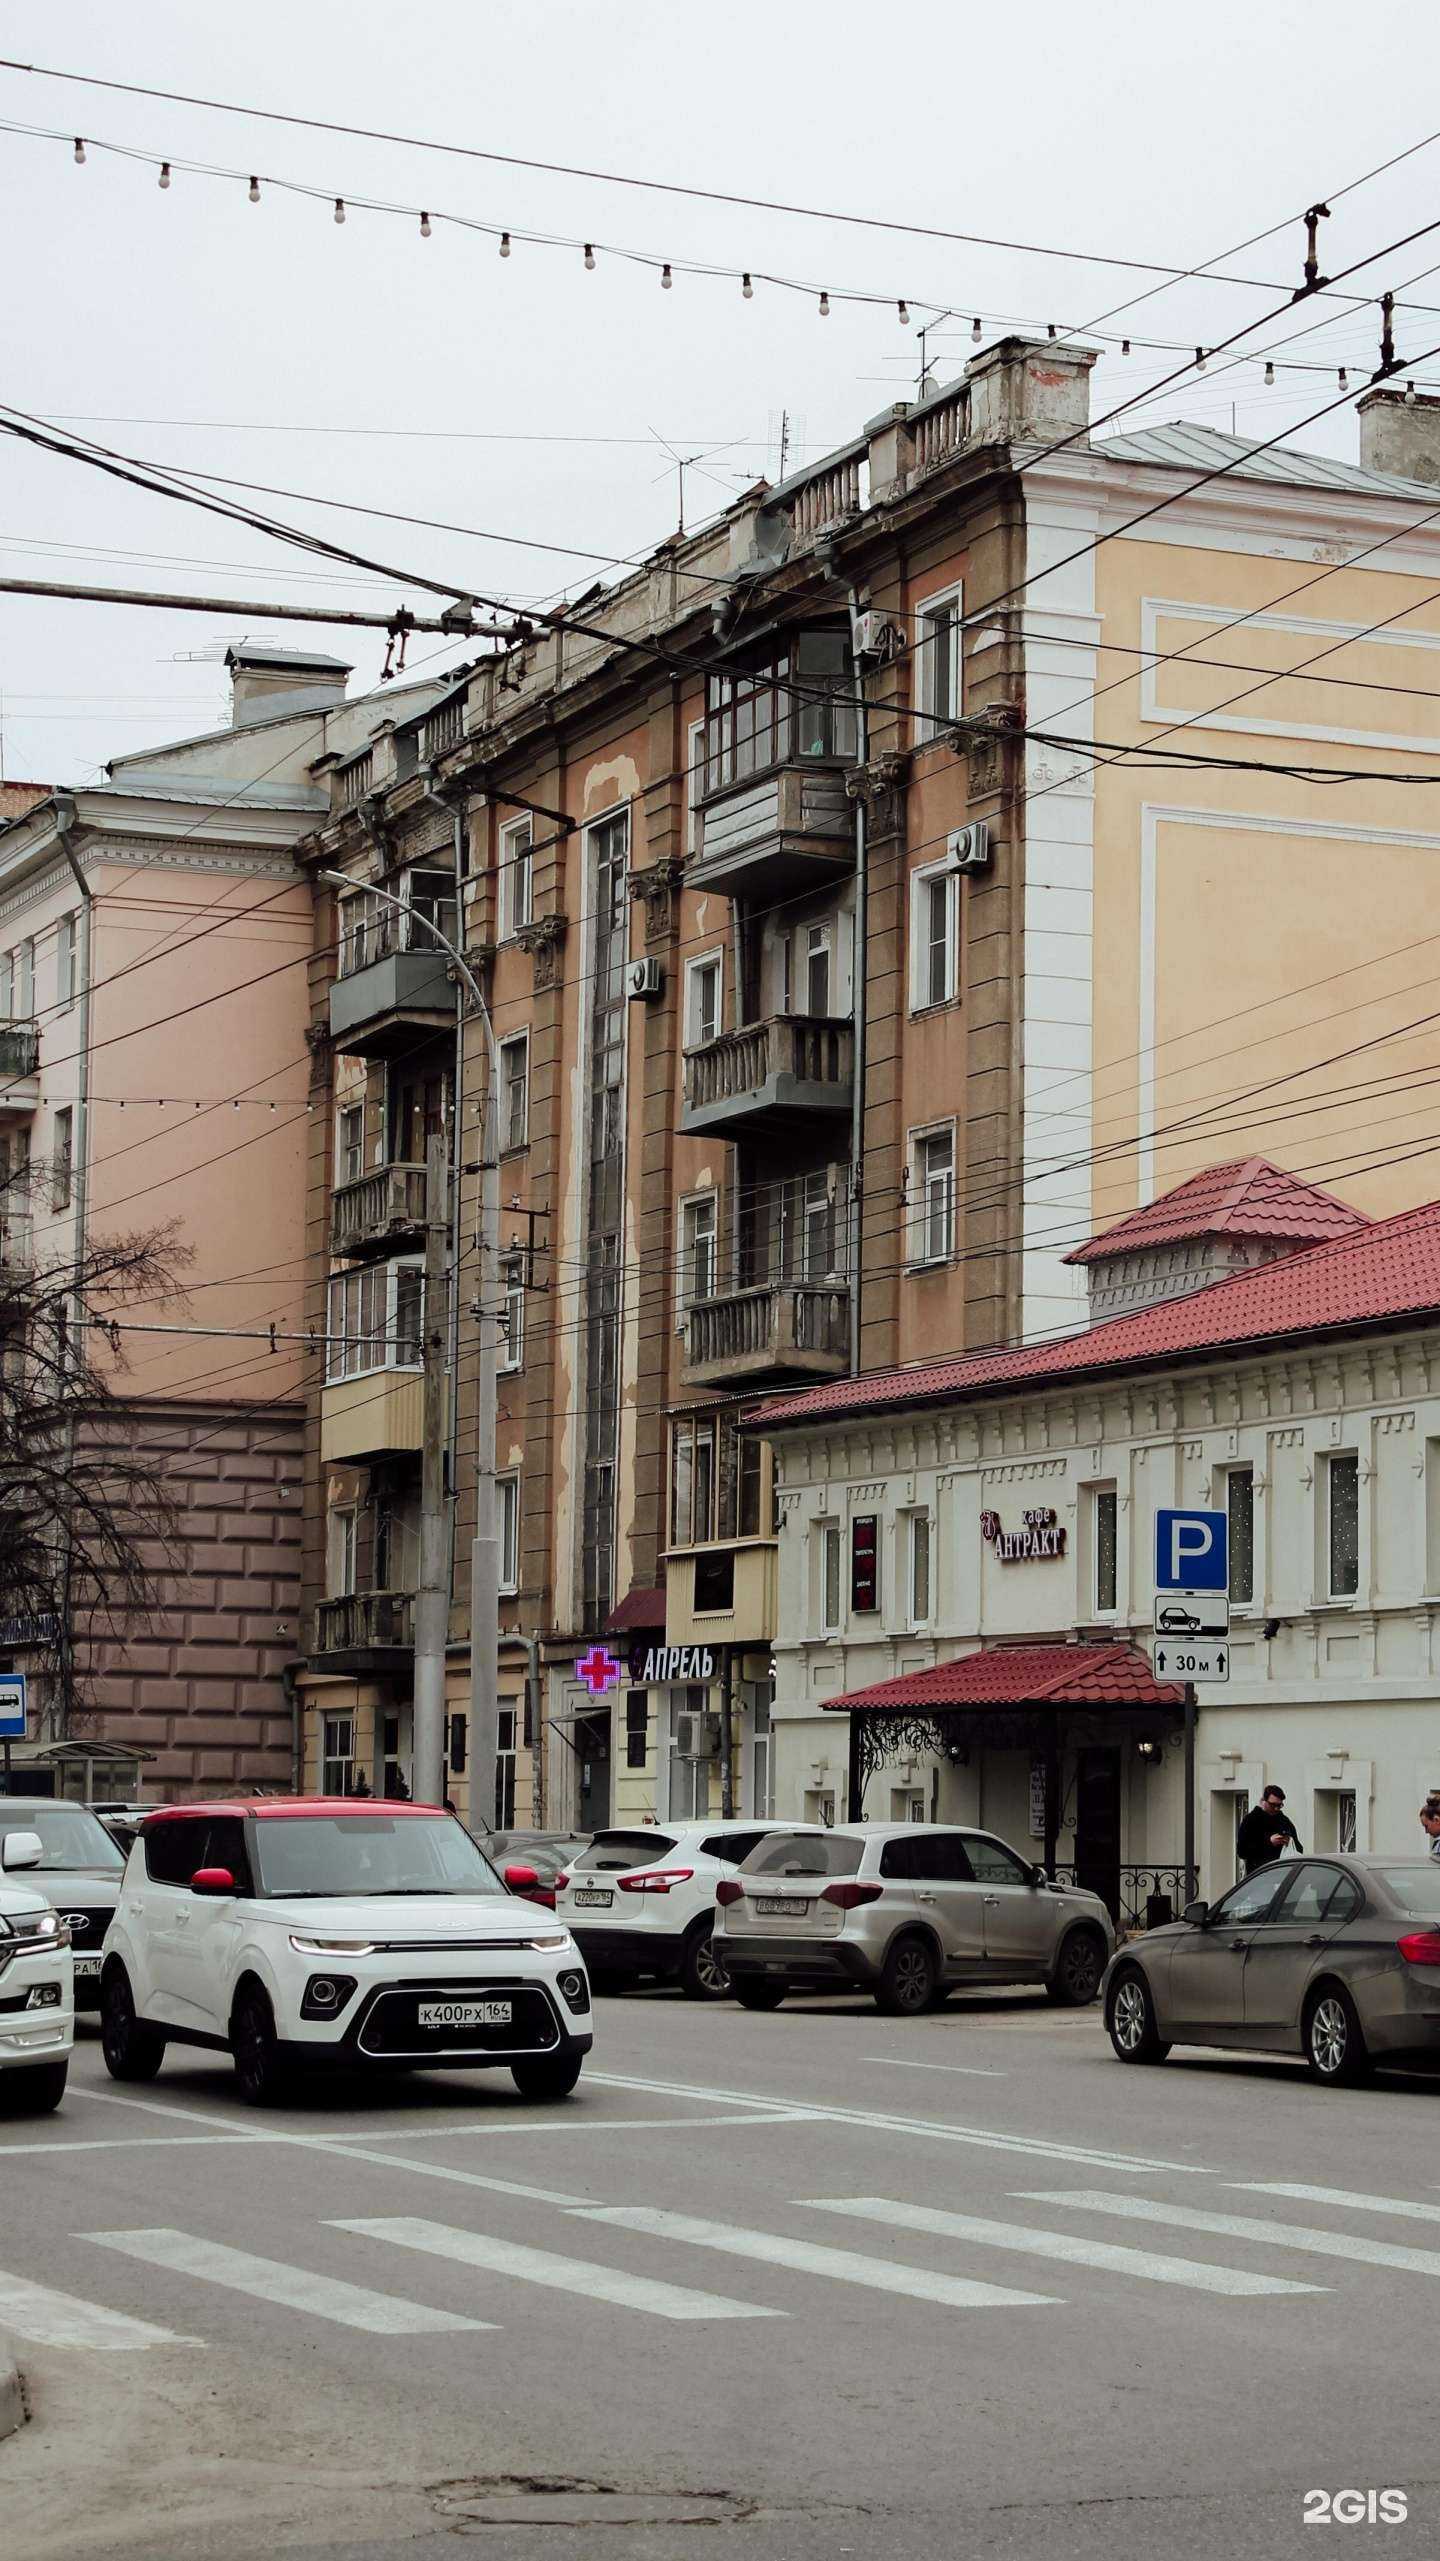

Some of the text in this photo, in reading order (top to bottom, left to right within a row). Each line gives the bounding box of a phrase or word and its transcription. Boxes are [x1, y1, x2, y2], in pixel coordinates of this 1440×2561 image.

[1022, 1508, 1050, 1528] кафе
[994, 1530, 1060, 1559] АНТРАКТ
[1171, 1519, 1213, 1580] P
[643, 1647, 713, 1681] АПРЕЛЬ
[1176, 1655, 1196, 1671] 30
[423, 2003, 510, 2022] К400РХ 164
